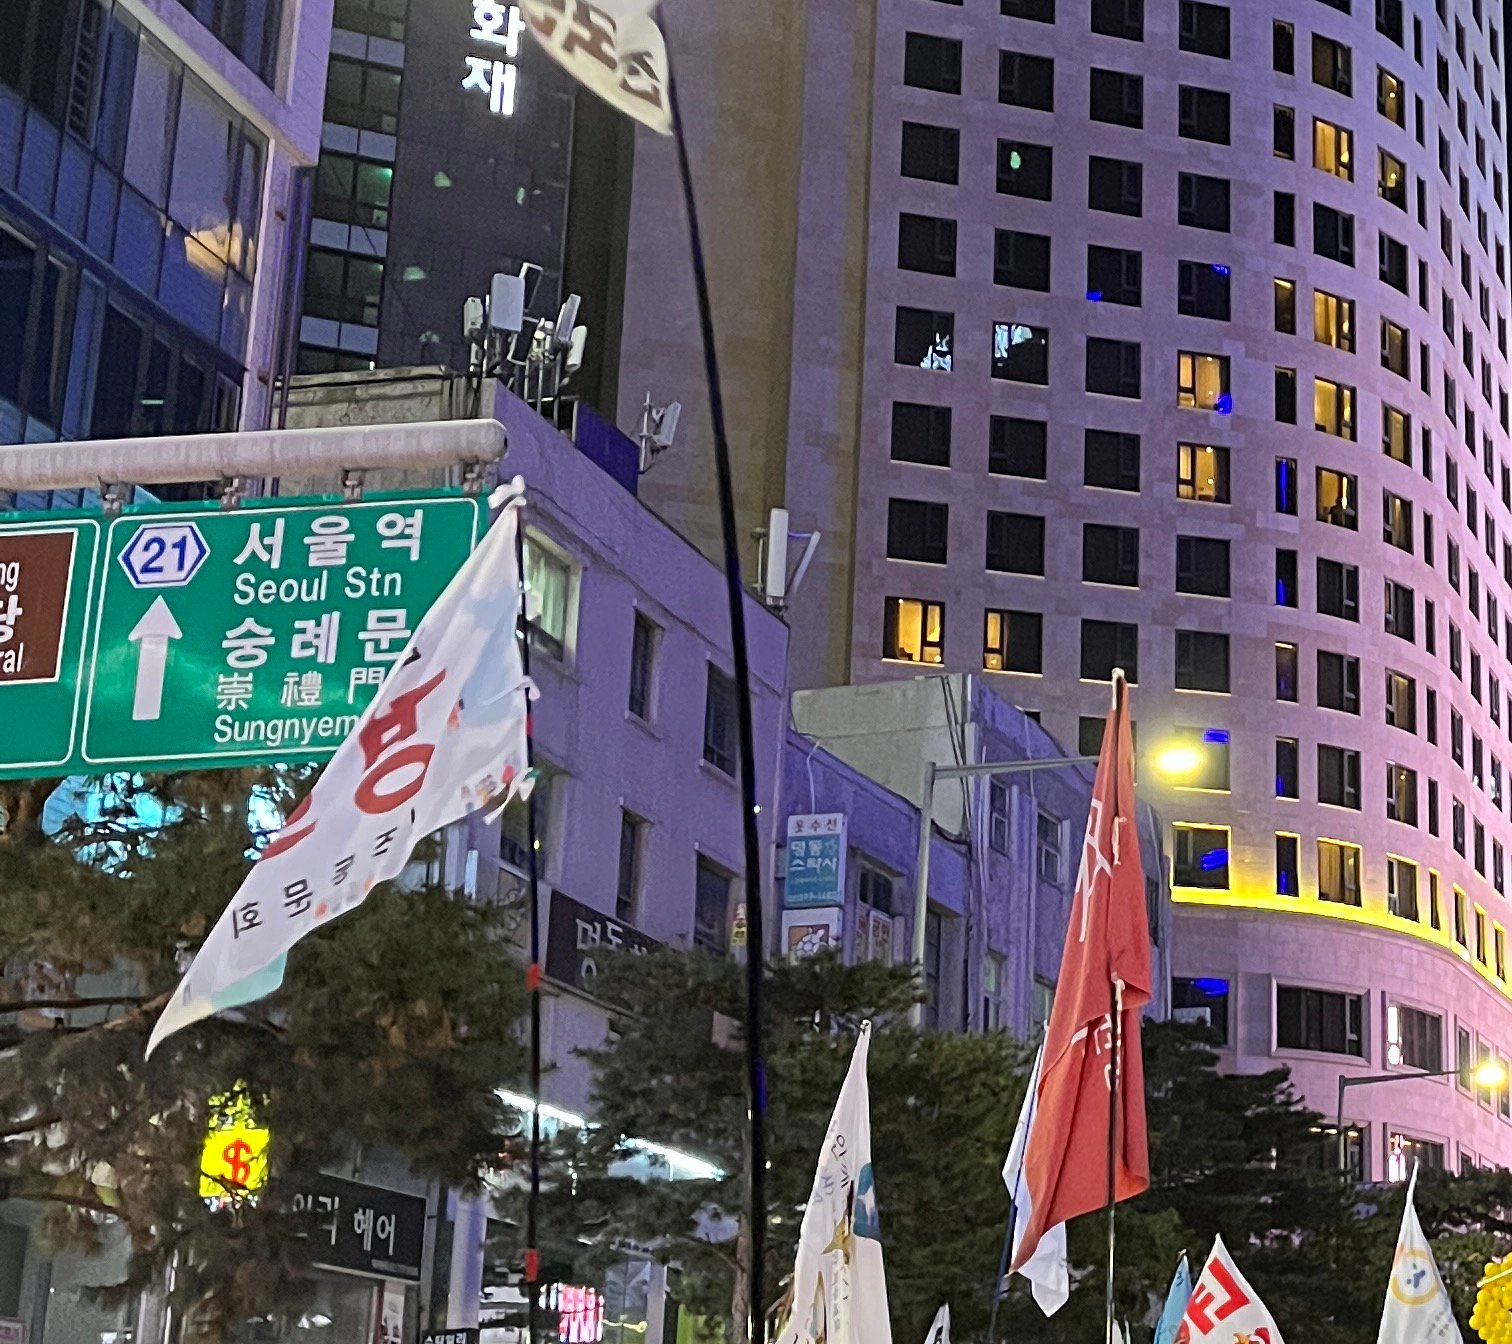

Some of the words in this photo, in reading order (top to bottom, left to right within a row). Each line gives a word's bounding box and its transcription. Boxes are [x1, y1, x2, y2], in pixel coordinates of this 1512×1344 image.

[139, 535, 189, 575] 21
[233, 509, 423, 570] 서울역
[233, 570, 328, 605] Seoul
[344, 566, 402, 599] Stn
[221, 608, 412, 669] 숭례문
[213, 714, 359, 748] Sungnyem
[353, 1207, 396, 1256] 헤어
